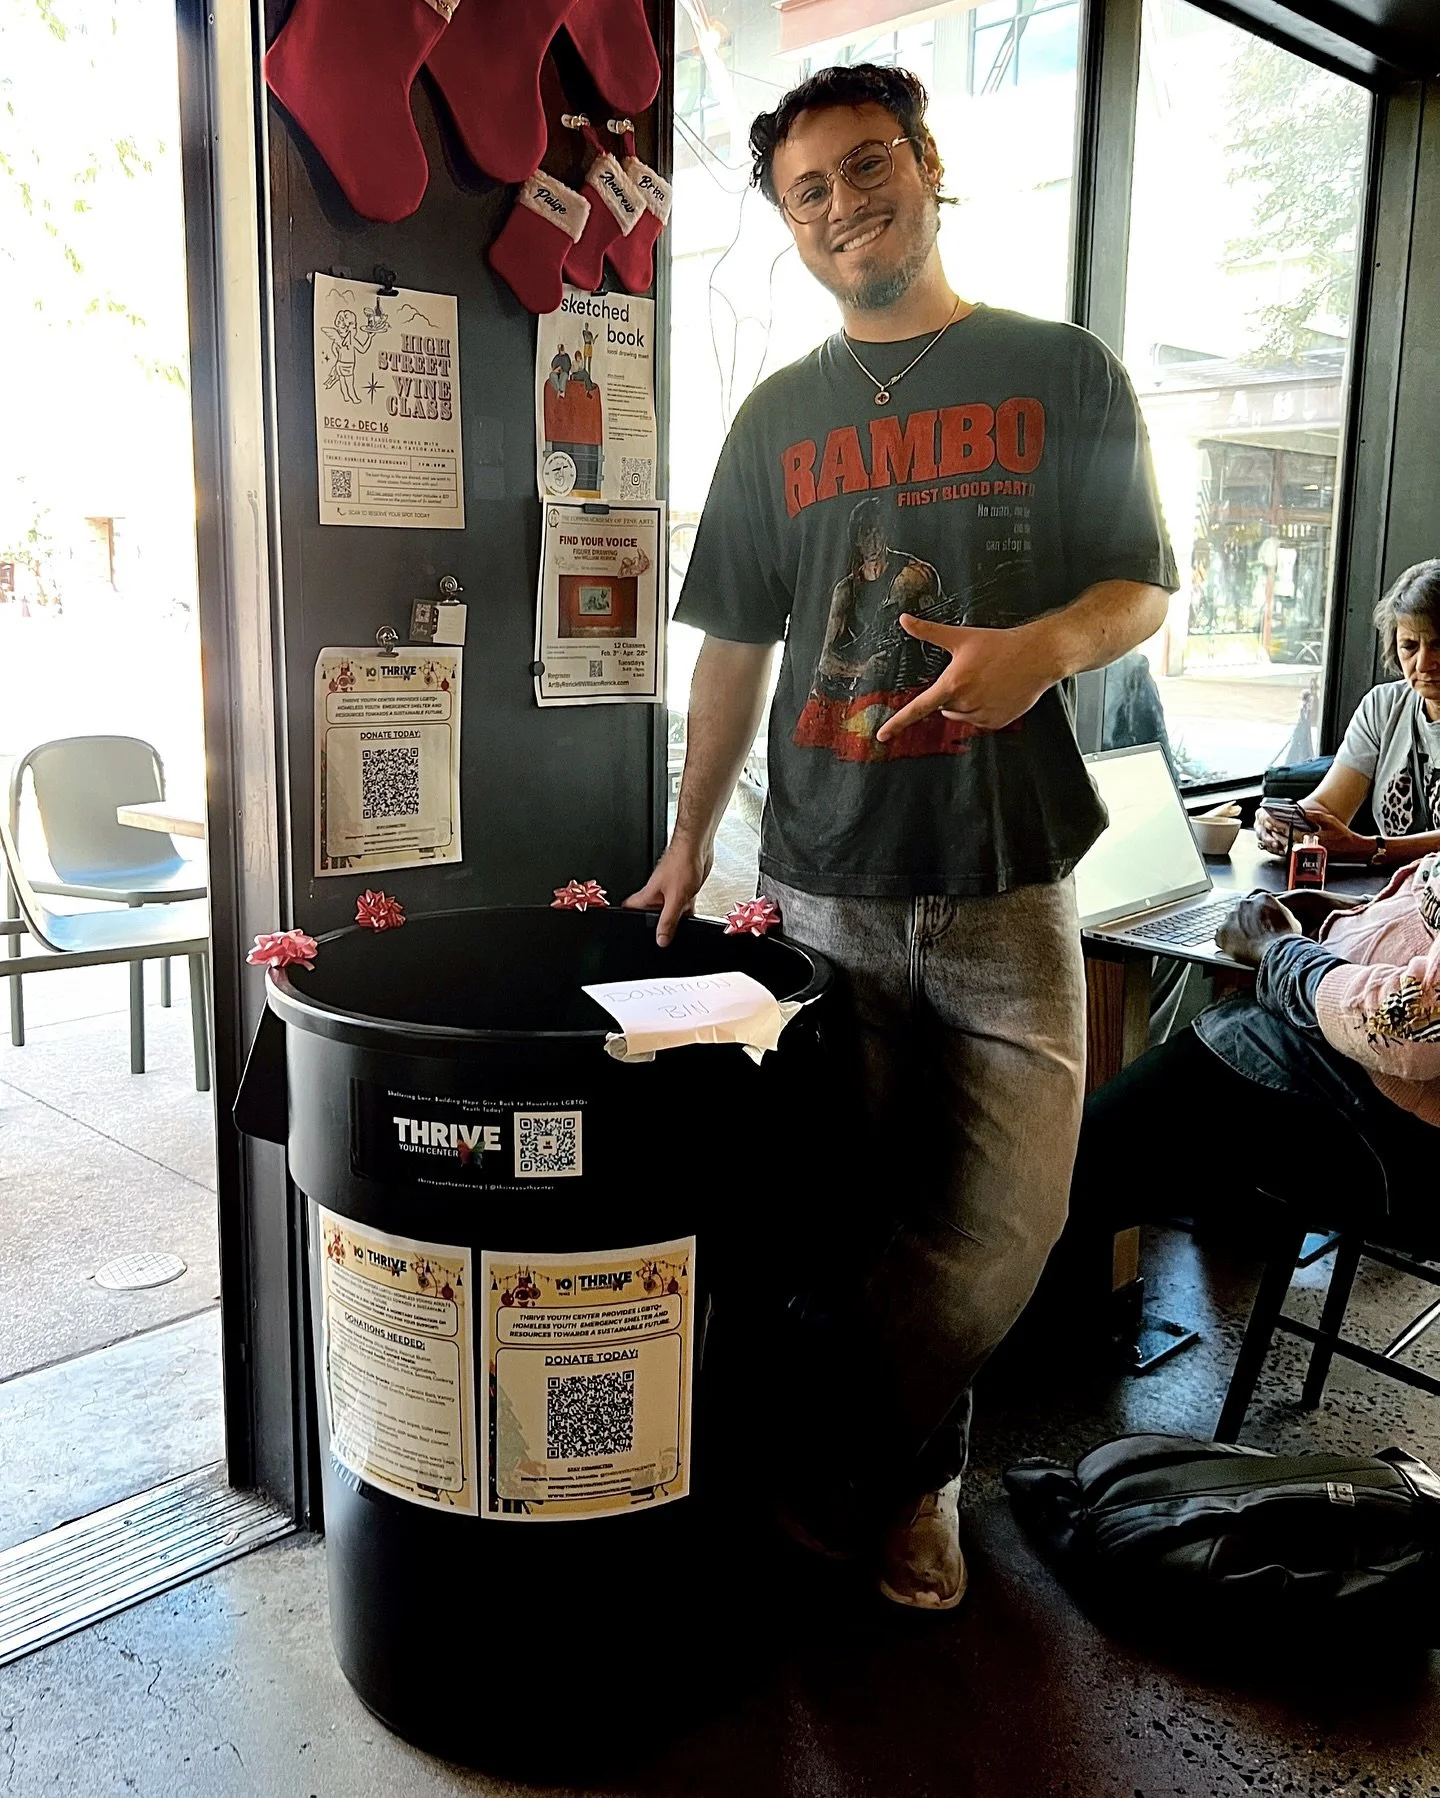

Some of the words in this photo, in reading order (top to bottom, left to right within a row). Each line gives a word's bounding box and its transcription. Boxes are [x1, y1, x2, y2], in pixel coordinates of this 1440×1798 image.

[533, 188, 567, 215] Paige
[600, 171, 635, 213] Andrew
[561, 293, 630, 322] sketched
[401, 333, 450, 358] HIGH
[607, 324, 645, 347] book
[378, 351, 451, 377] STREET
[392, 375, 451, 401] WINE
[386, 395, 452, 421] CLASS
[324, 416, 342, 428] DEC
[344, 420, 349, 428] 2
[358, 420, 377, 431] DEC
[380, 423, 389, 432] 16
[781, 396, 1046, 518] RAMBO
[898, 488, 937, 507] FIRST
[942, 484, 990, 501] BLOOD
[994, 481, 1028, 497] PART
[978, 504, 989, 517] No
[560, 535, 578, 545] FIND
[580, 536, 604, 547] YOUR
[606, 538, 638, 548] VOICE
[986, 540, 1000, 551] can
[1002, 538, 1022, 552] stop
[366, 668, 376, 677] 10
[380, 666, 417, 676] THRIVE
[360, 731, 392, 740] DONATE
[604, 977, 732, 1002] DONATION
[658, 1000, 710, 1019] BIN
[388, 1090, 416, 1101] Sheltering
[435, 1096, 461, 1105] Building
[483, 1106, 504, 1114] Today!
[393, 1116, 502, 1151] THRIVE
[399, 1143, 425, 1154] YOUTH
[426, 1146, 459, 1158] CENTER
[367, 1249, 408, 1273] THRIVE
[555, 1278, 572, 1291] 10
[578, 1271, 633, 1287] THRIVE
[580, 1319, 623, 1328] EMERGENCY
[624, 1314, 653, 1324] SHELTER
[654, 1310, 669, 1318] AND
[602, 1308, 636, 1318] PROVIDES
[638, 1304, 662, 1313] LGBTQ+
[344, 1312, 386, 1338] DONATIONS
[387, 1332, 426, 1351] NEEDED:
[554, 1330, 589, 1338] TOWARDS
[597, 1324, 643, 1335] SUSTAINABLE
[544, 1354, 594, 1366] DONATE
